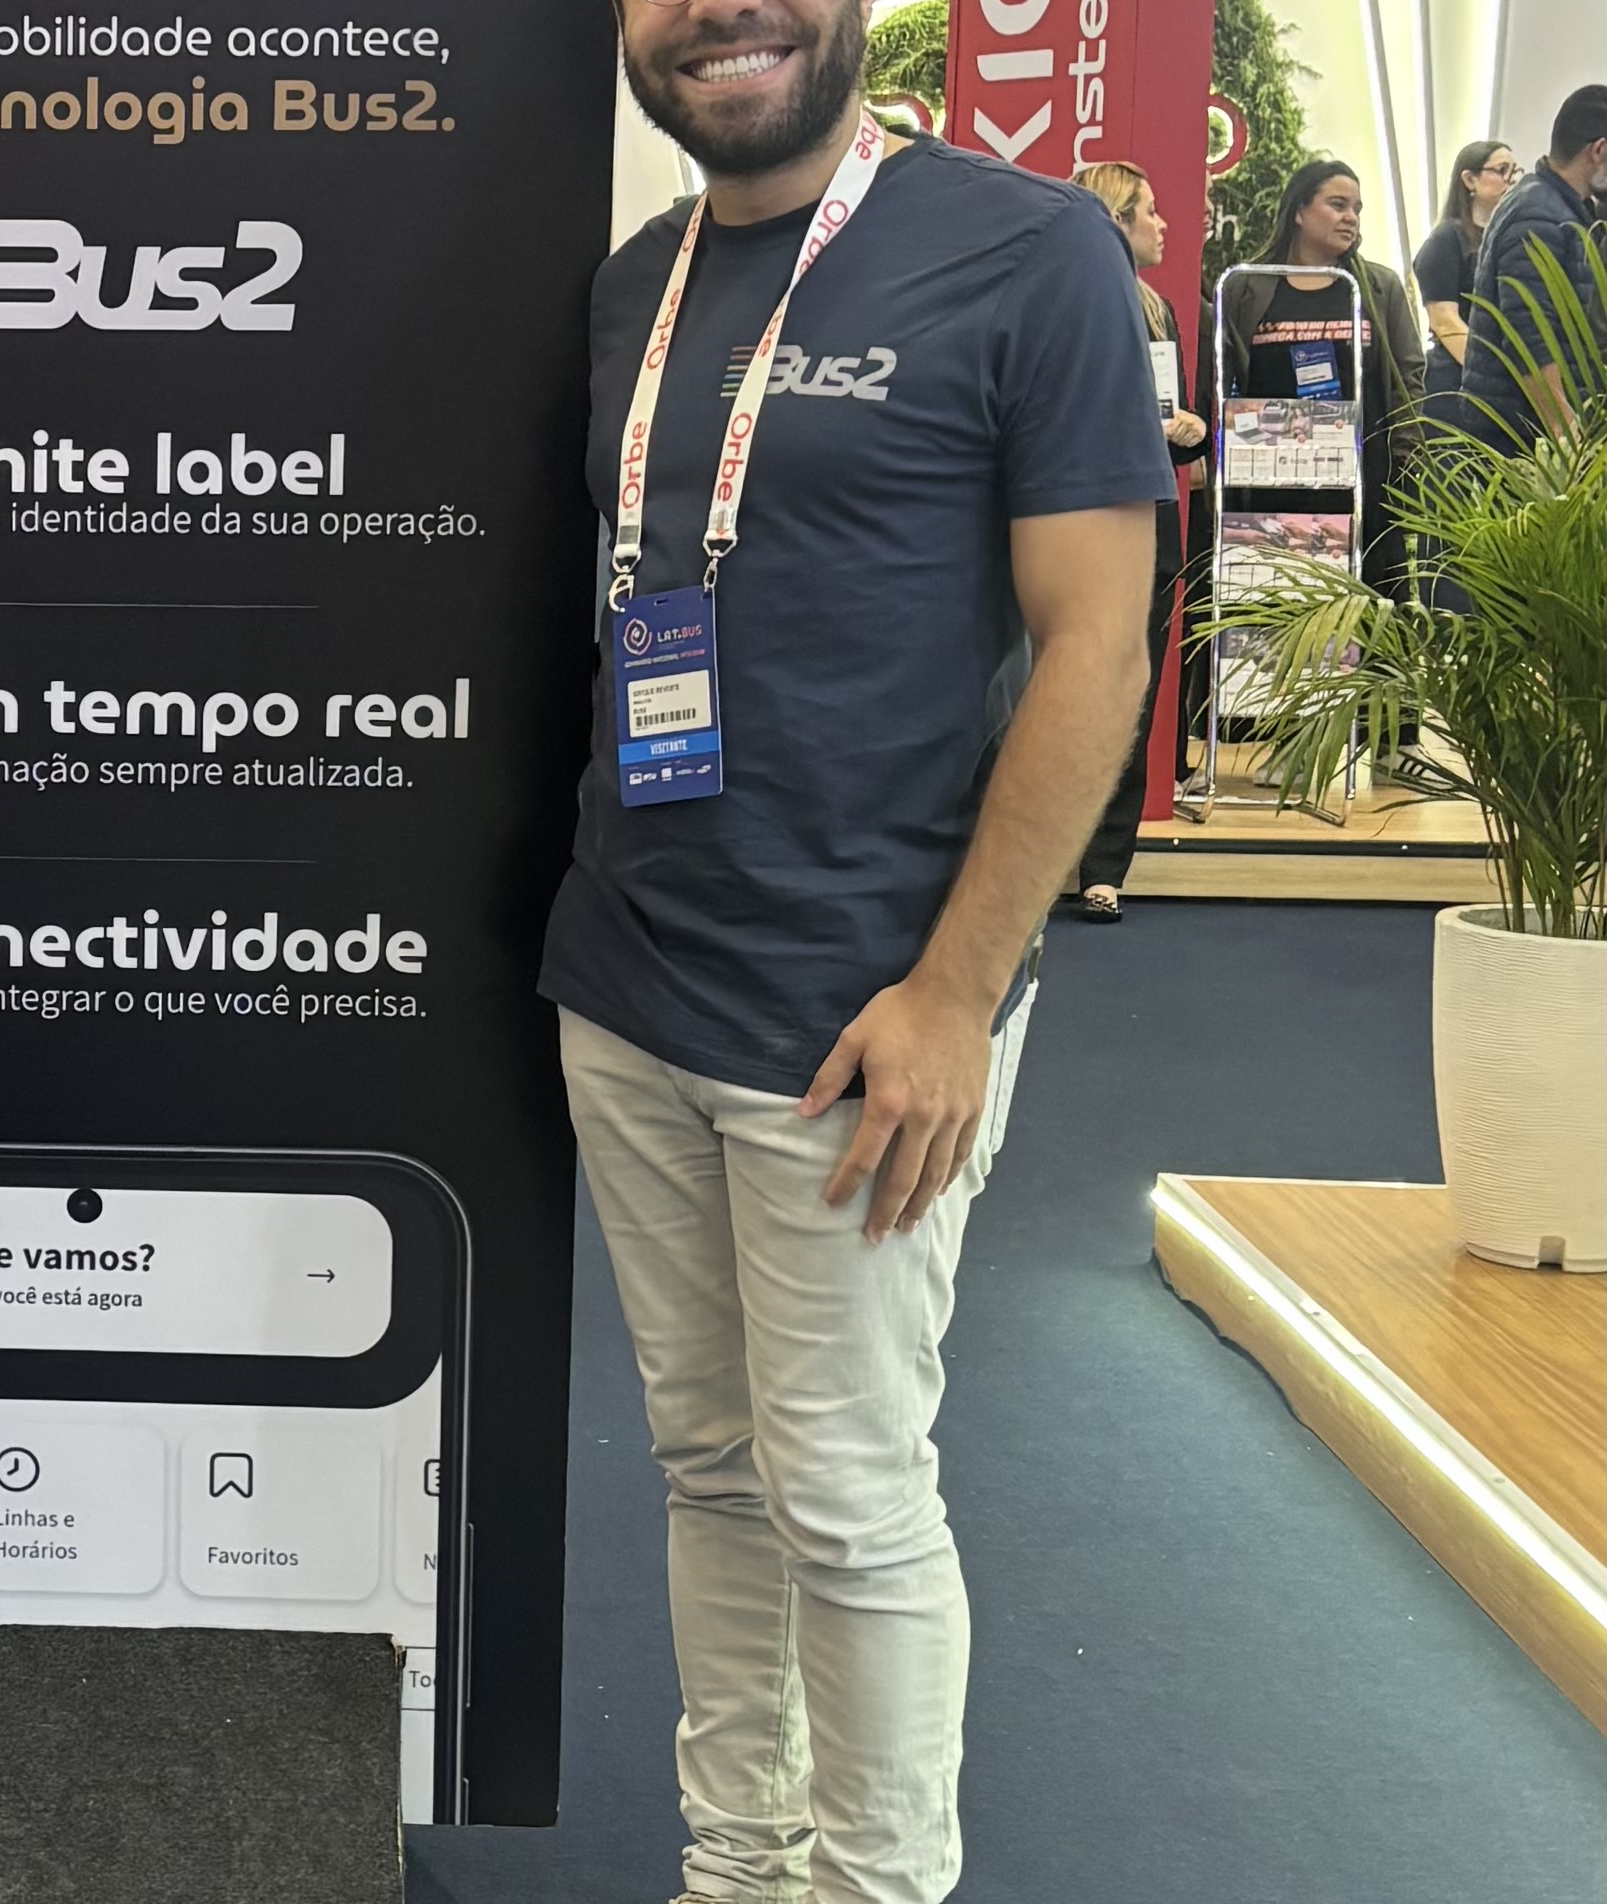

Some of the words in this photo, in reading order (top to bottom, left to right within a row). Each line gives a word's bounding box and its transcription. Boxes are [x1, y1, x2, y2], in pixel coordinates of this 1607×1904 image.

[227, 20, 450, 65] acontece,
[273, 79, 456, 132] Bus2.
[854, 111, 883, 161] rbe
[646, 287, 681, 370] Orbe
[763, 343, 898, 402] Bus2
[156, 432, 345, 497] label
[621, 420, 648, 510] Orbe
[716, 411, 752, 503] Orbe
[10, 501, 192, 534] identidade
[201, 502, 241, 535] da
[251, 511, 309, 536] sua
[319, 504, 485, 545] operação.
[656, 623, 703, 644] LAT.BUS
[44, 680, 300, 753] tempo
[325, 677, 470, 739] real
[99, 758, 223, 793] sempre
[232, 754, 413, 788] atualizada.
[114, 991, 134, 1013] o
[144, 992, 206, 1021] que
[214, 984, 290, 1016] você
[298, 987, 427, 1023] precisa.
[22, 1242, 156, 1273] vamos?
[42, 1286, 82, 1306] está
[87, 1291, 143, 1311] agora
[63, 1514, 75, 1528] e
[208, 1546, 299, 1567] Favoritos
[408, 1670, 436, 1689] To
